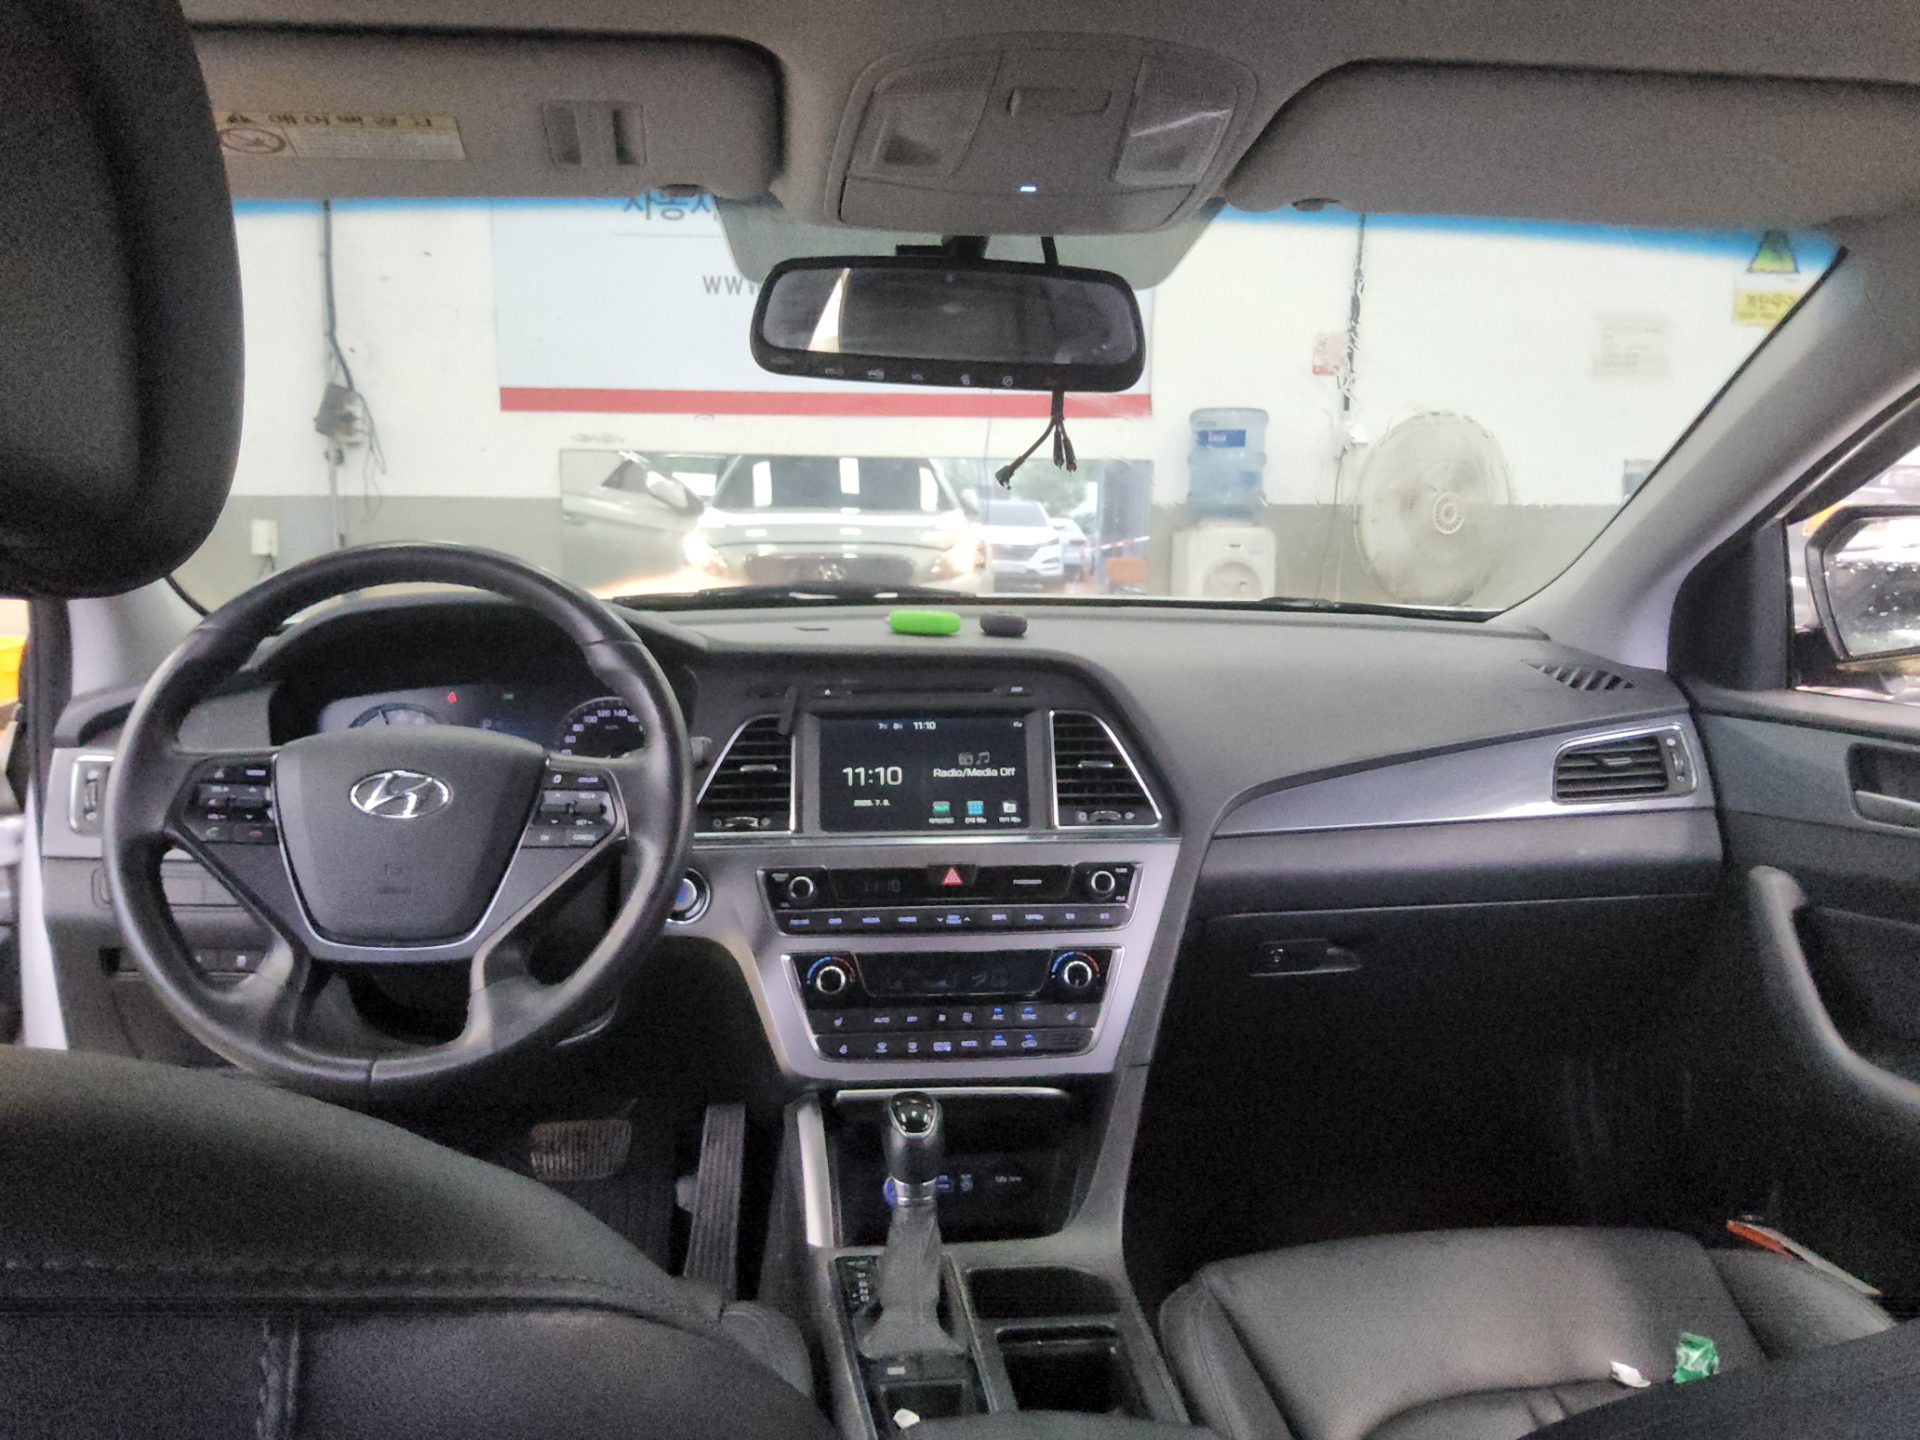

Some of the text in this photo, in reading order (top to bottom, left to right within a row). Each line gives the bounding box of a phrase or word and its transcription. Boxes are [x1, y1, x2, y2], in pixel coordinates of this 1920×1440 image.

[597, 709, 628, 718] 120 140
[912, 721, 937, 730] 11:10
[842, 766, 903, 786] 11:10
[933, 767, 1016, 778] Radio/Media Off
